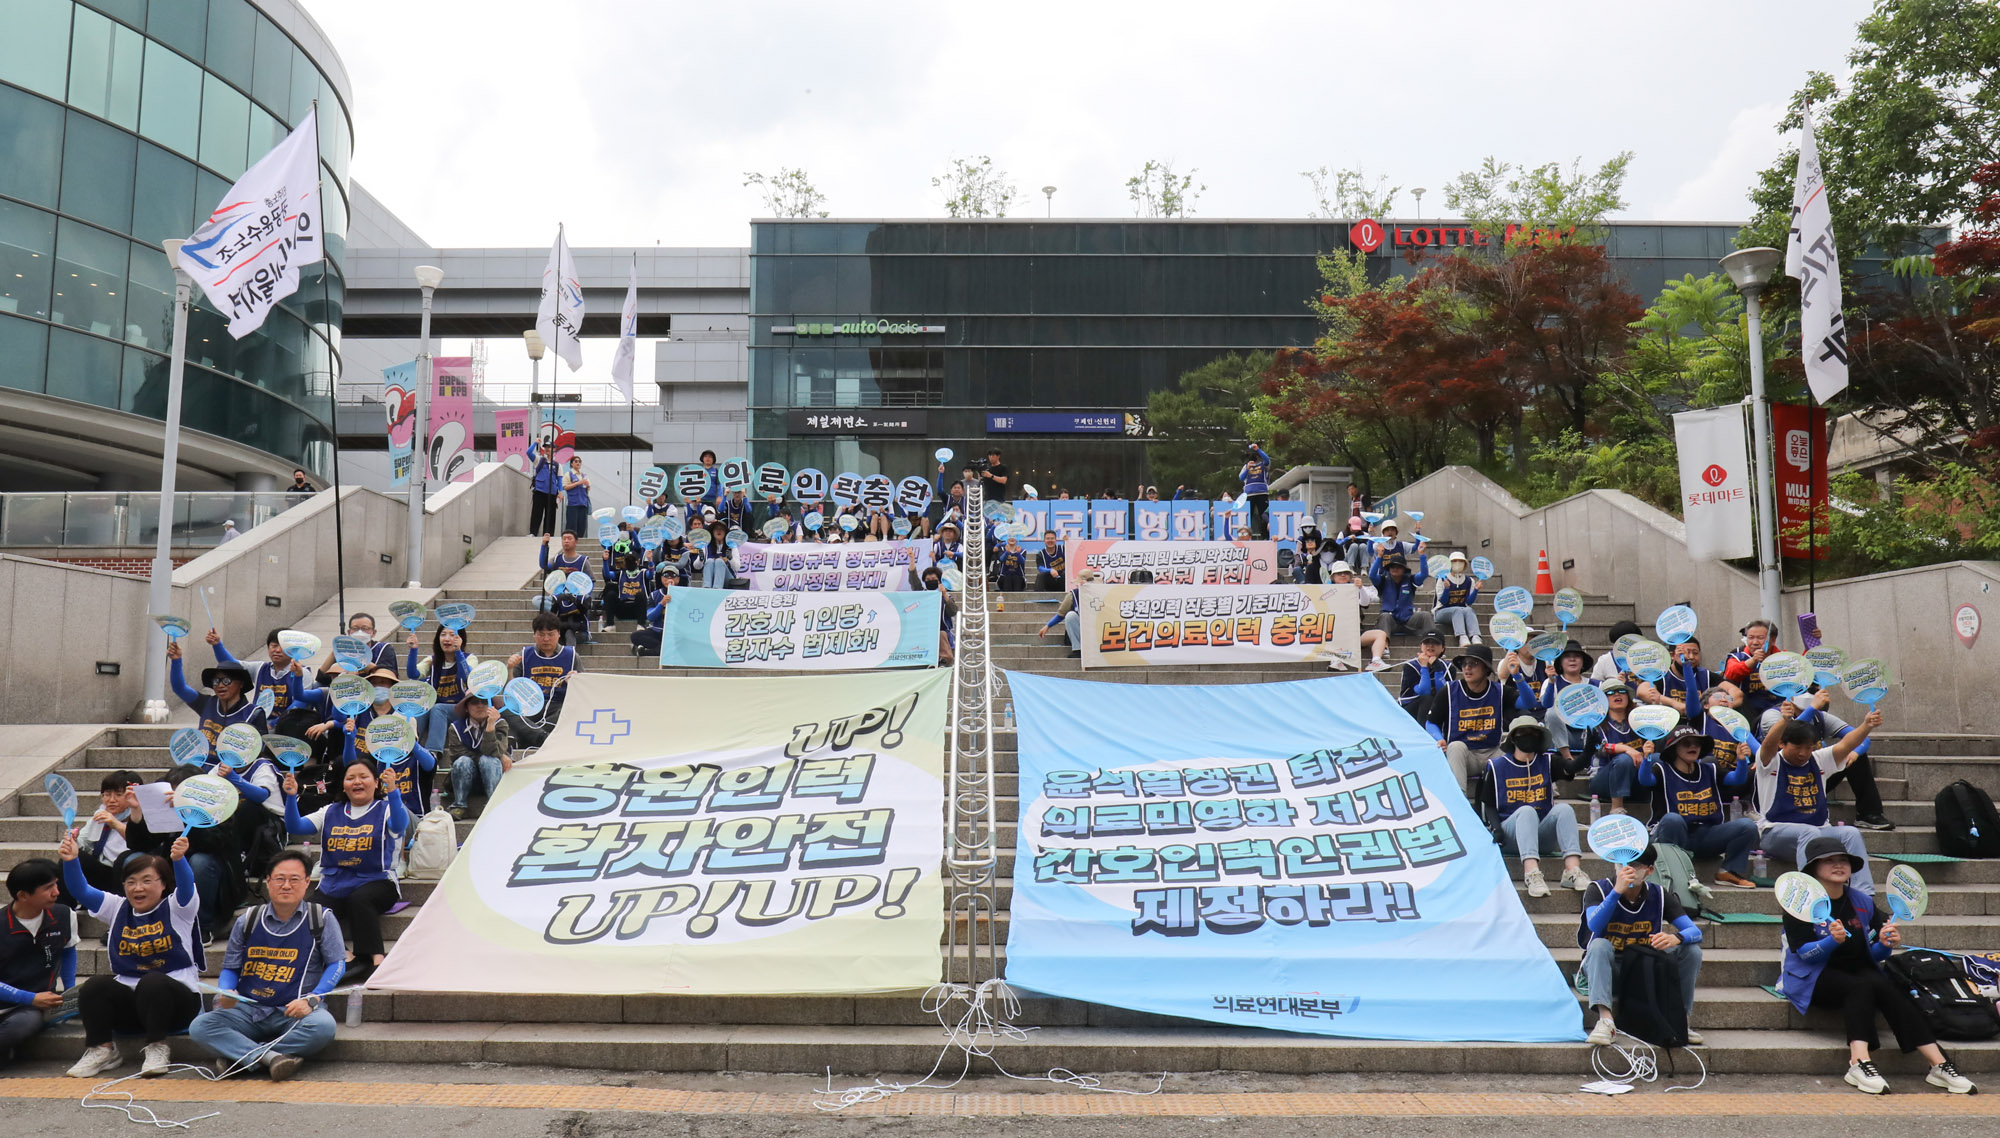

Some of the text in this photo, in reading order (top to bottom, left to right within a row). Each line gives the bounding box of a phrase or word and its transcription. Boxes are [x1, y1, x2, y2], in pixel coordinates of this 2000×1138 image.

[1394, 227, 1490, 246] LOTTE
[807, 415, 868, 428] 제일제면소
[1688, 487, 1746, 507] 롯데마트
[772, 550, 840, 572] 비정규직
[845, 547, 920, 570] 정규직화!
[1086, 547, 1249, 568] 직무성과급제 및 노동개악 저지!
[773, 571, 888, 592] 의사정원 확대!
[725, 594, 798, 611] 간호인력 충원!
[1119, 591, 1301, 618] 병원인력 직종별 기준마련
[725, 603, 863, 638] 간호사 1인당
[1100, 613, 1336, 653] 보건의료인력 충원!
[725, 629, 879, 664] 환자수 법제화!
[784, 692, 919, 760] UP!
[1287, 737, 1403, 790] 퇴진!
[537, 754, 876, 818] 병원인력
[1041, 772, 1430, 838] 의료민영화 저지!
[327, 837, 373, 852] 인력충원!
[506, 808, 895, 888] 환자안전
[1034, 815, 1468, 883] 간호인력인권법
[1132, 881, 1423, 936] 제정하라!
[243, 961, 296, 983] 인력충원!
[1212, 995, 1343, 1021] 의료연대본부
